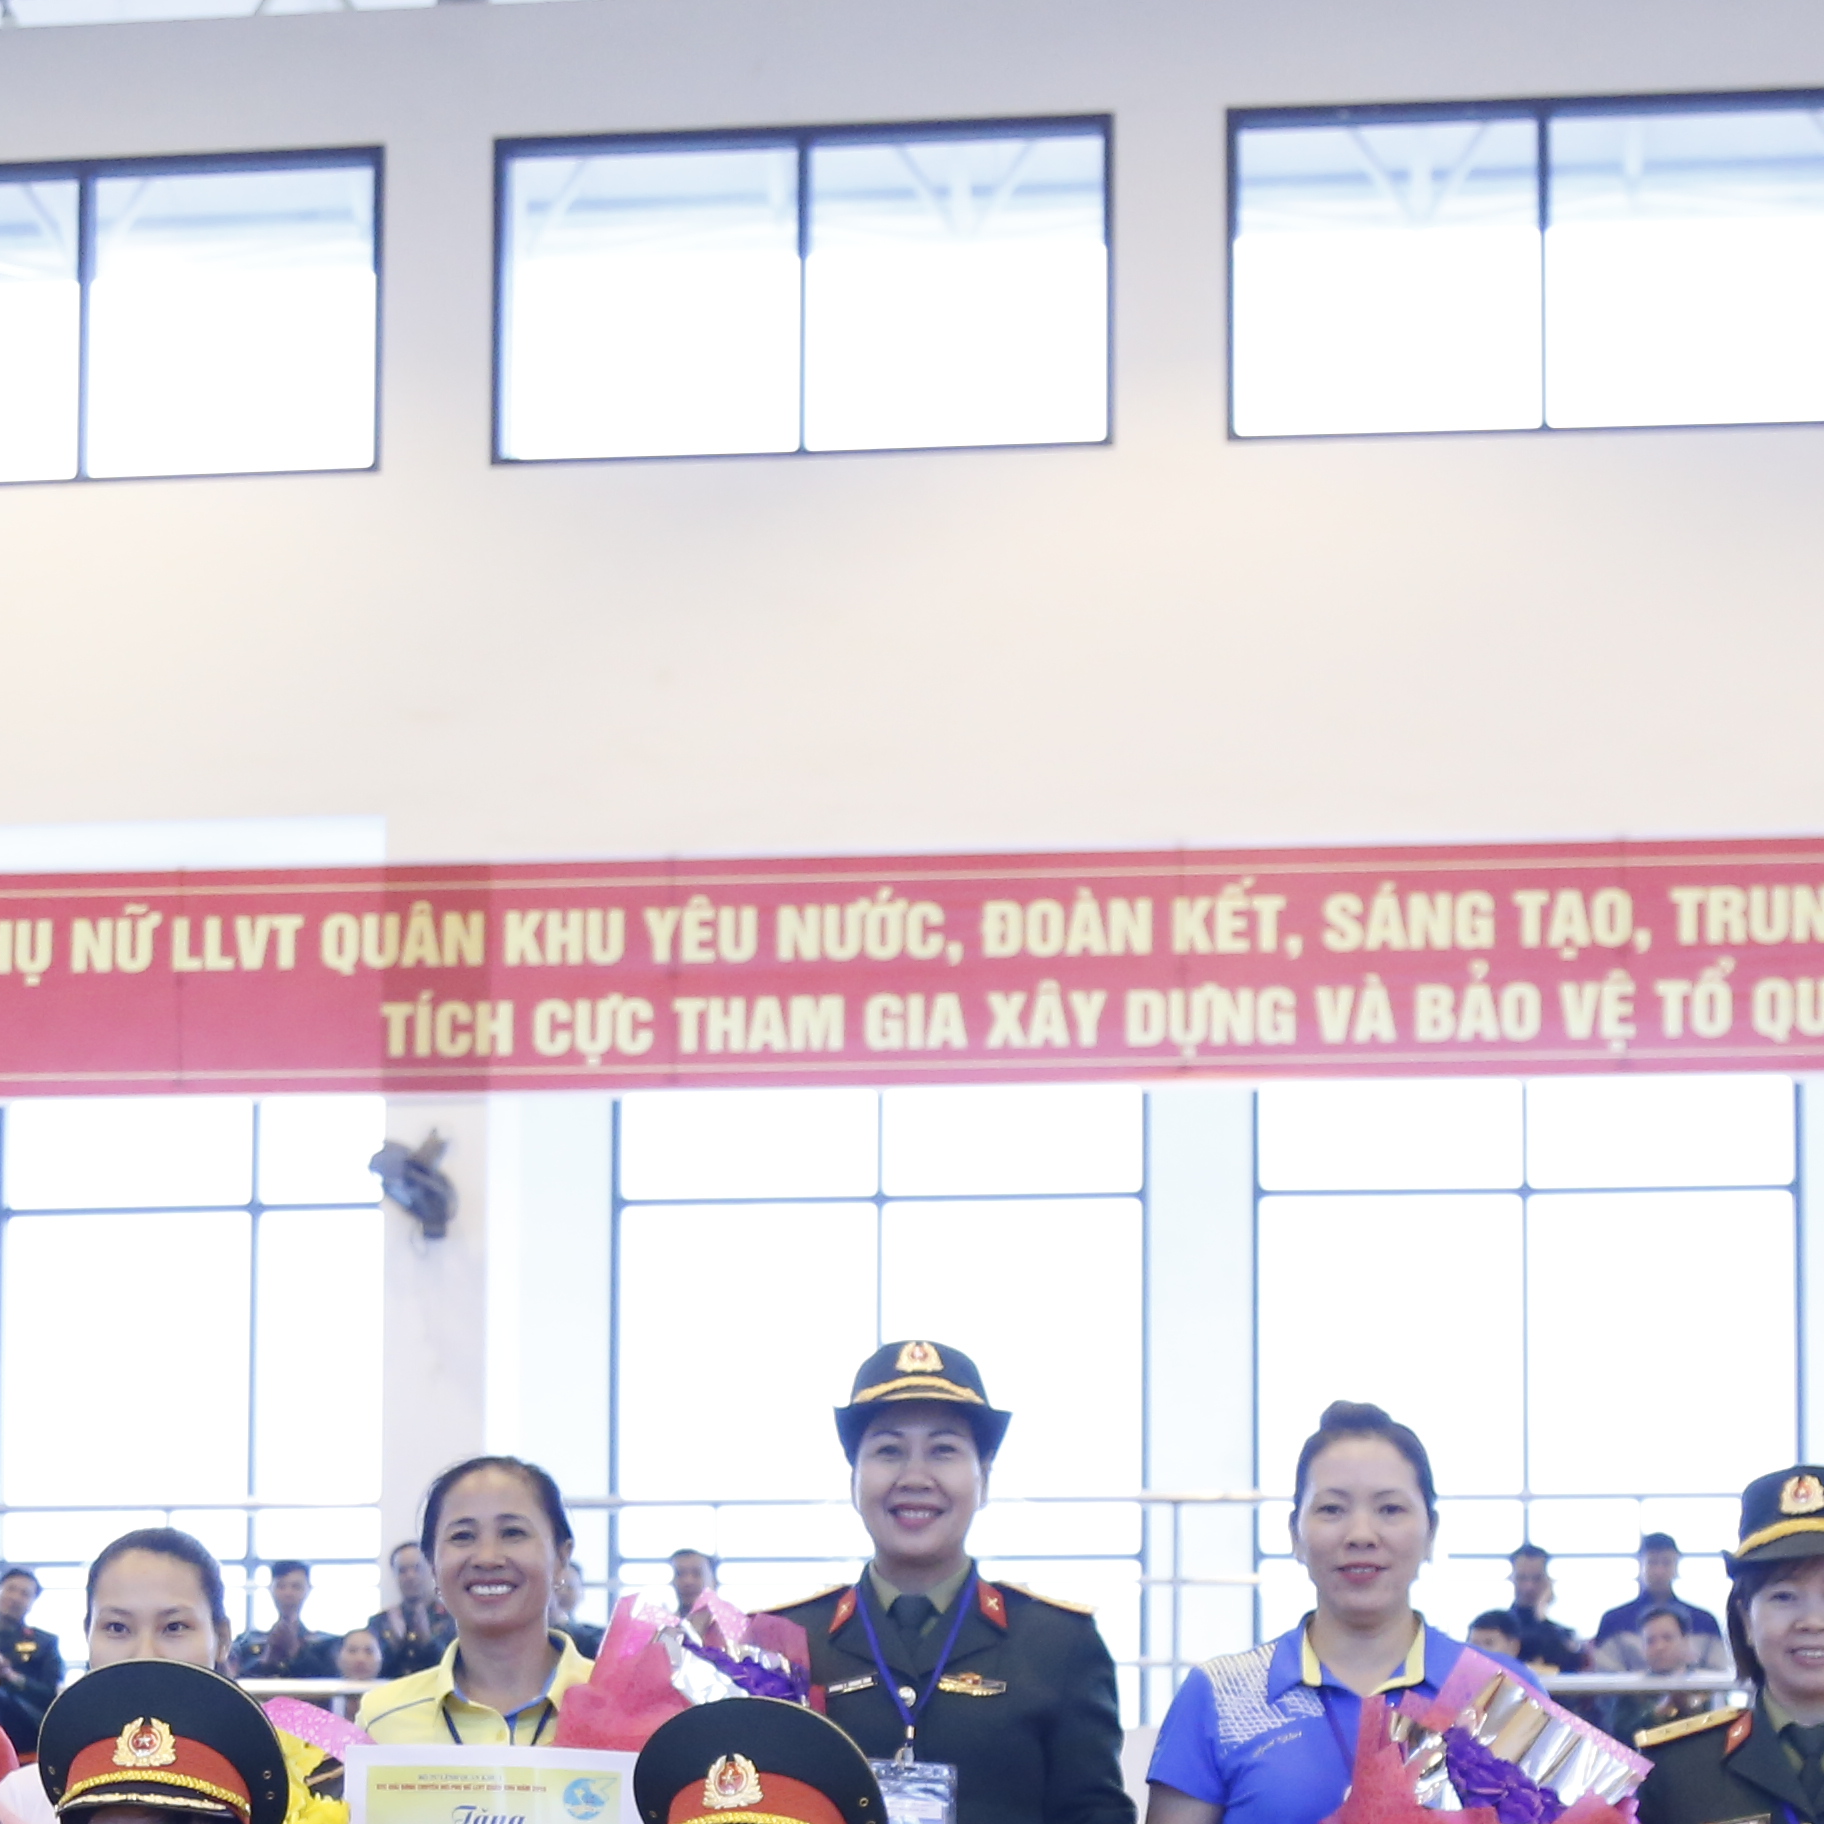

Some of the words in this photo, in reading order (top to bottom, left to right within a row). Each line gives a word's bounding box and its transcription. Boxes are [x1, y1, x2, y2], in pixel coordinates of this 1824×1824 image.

[71, 905, 161, 975] NỮ
[172, 914, 303, 973] LLVT
[321, 902, 485, 973] QUÂN
[505, 906, 625, 966] KHU
[645, 897, 757, 964] YÊU
[777, 890, 963, 966] NƯỚC,
[981, 883, 1154, 960] ĐOÀN
[1173, 878, 1302, 958] KẾT,
[1322, 878, 1494, 953] SÁNG
[1516, 889, 1650, 961] TẠO,
[383, 984, 512, 1058] TÍCH
[533, 995, 653, 1065] CỰC
[673, 992, 846, 1054] THAM
[864, 992, 966, 1052] GIA
[987, 980, 1107, 1048] XÂY
[1127, 983, 1296, 1055] DỰNG
[1317, 975, 1395, 1042] VÀ
[1416, 961, 1540, 1040] BẢO
[1561, 970, 1635, 1053] VỆ
[1655, 959, 1735, 1035] TỔ
